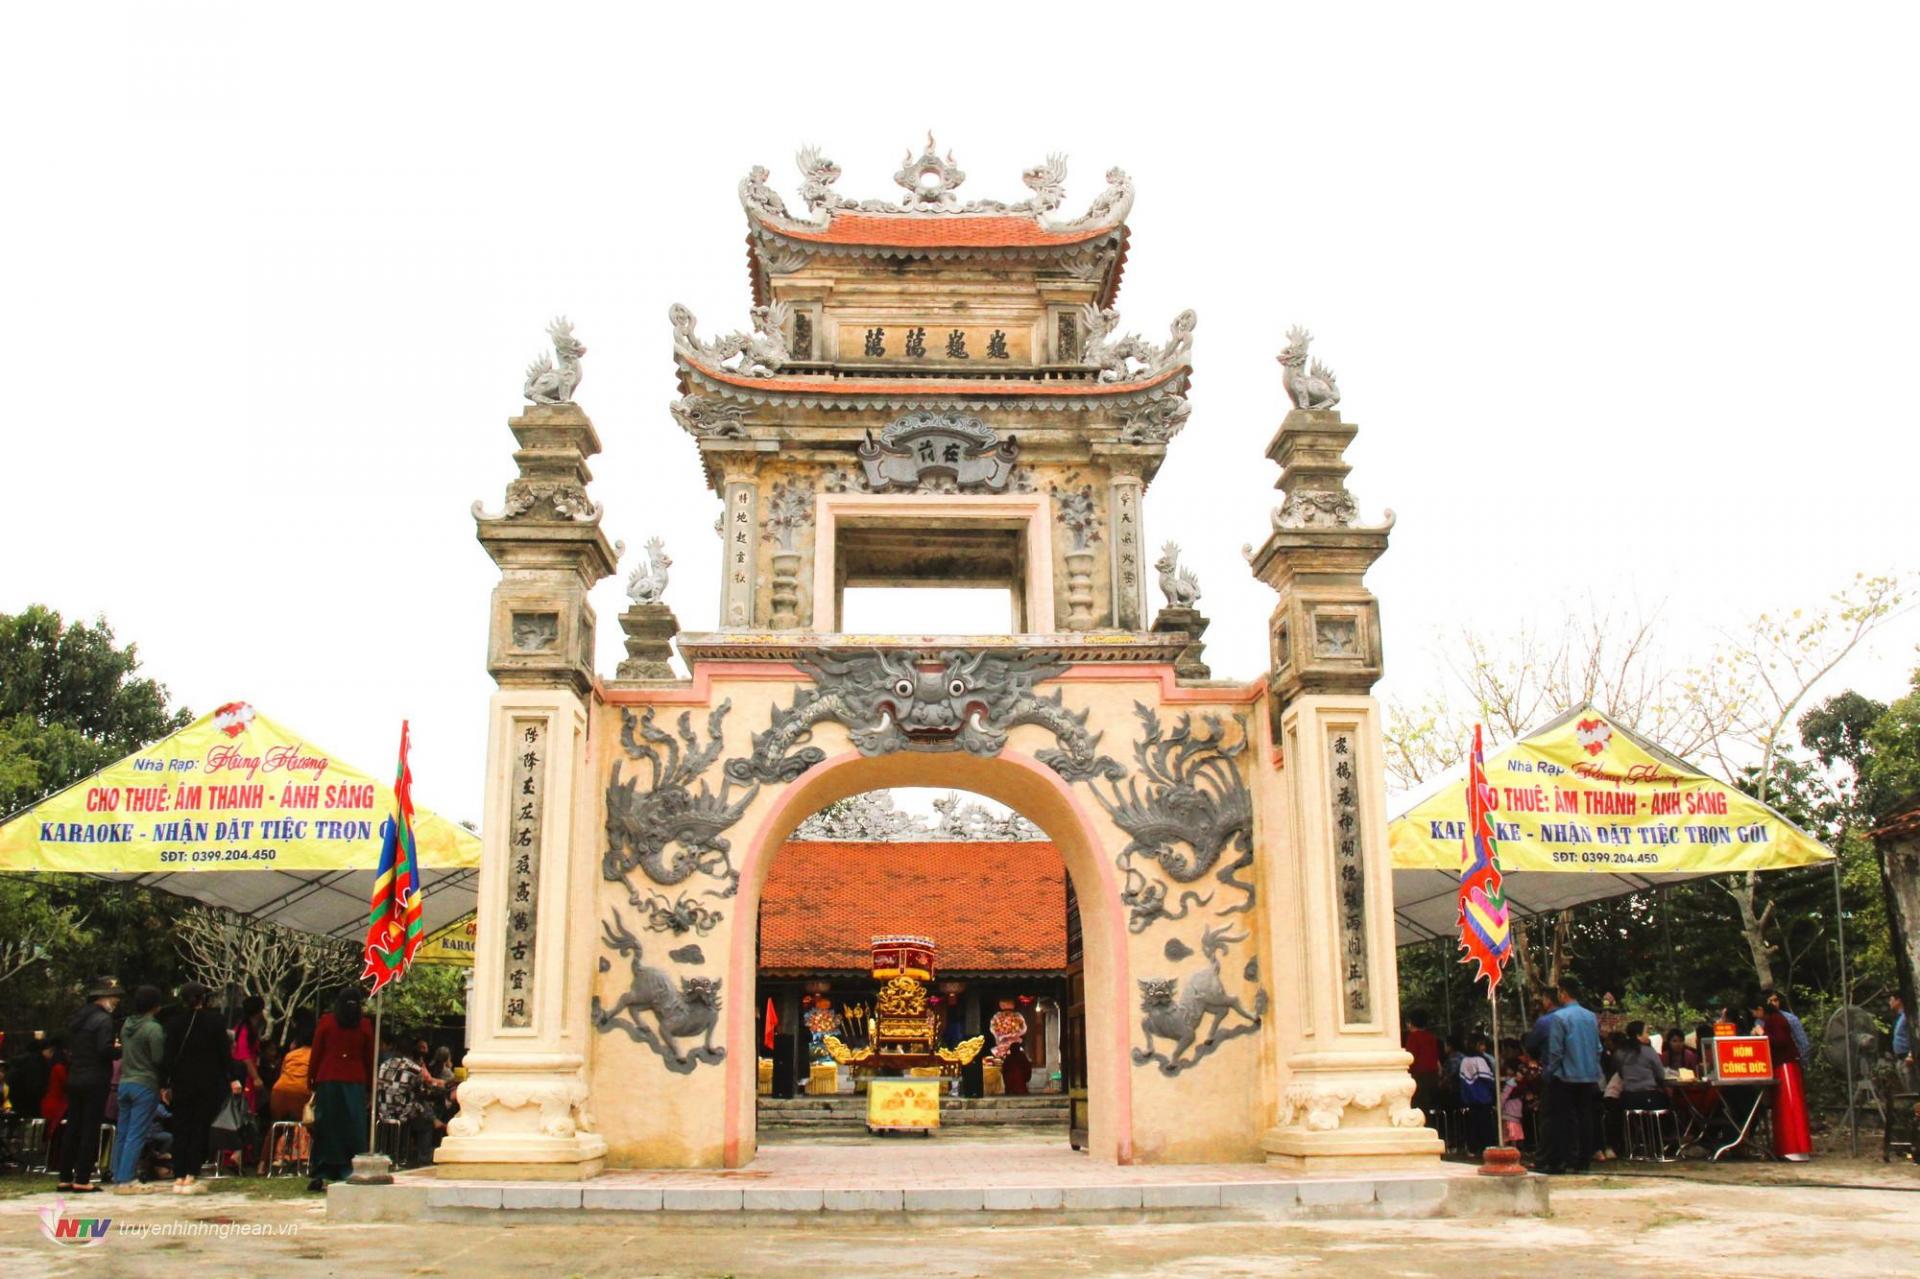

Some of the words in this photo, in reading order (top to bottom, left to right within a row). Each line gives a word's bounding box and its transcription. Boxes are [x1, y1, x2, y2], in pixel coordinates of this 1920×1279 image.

[86, 787, 120, 812] CHO
[125, 783, 170, 812] THUÊ:
[174, 781, 203, 810] ÂM
[208, 785, 264, 809] THANH
[280, 781, 320, 809] ÁNH
[324, 780, 374, 809] SÁNG
[1503, 784, 1549, 813] THUÊ:
[1554, 785, 1578, 814] ÂM
[1584, 791, 1636, 815] THANH
[1651, 789, 1683, 815] ÁNH
[1685, 787, 1728, 815] SÁNG
[40, 822, 134, 843] KARAOKE
[152, 818, 209, 845] NHẬN
[215, 818, 254, 843] ĐẶT
[261, 816, 307, 843] TIỆC
[315, 820, 371, 843] TRỌN
[1541, 821, 1592, 845] NHẬN
[1597, 824, 1632, 847] ĐẶT
[1637, 823, 1680, 847] TIỆC
[1685, 826, 1731, 846] TRỌN
[1736, 822, 1769, 843] GÓI
[160, 851, 187, 862] SĐT:
[192, 849, 276, 862] 0399.204.450
[1552, 852, 1577, 863] SĐT:
[1582, 852, 1659, 864] 0399.204.450
[1722, 1060, 1747, 1073] CÔNG
